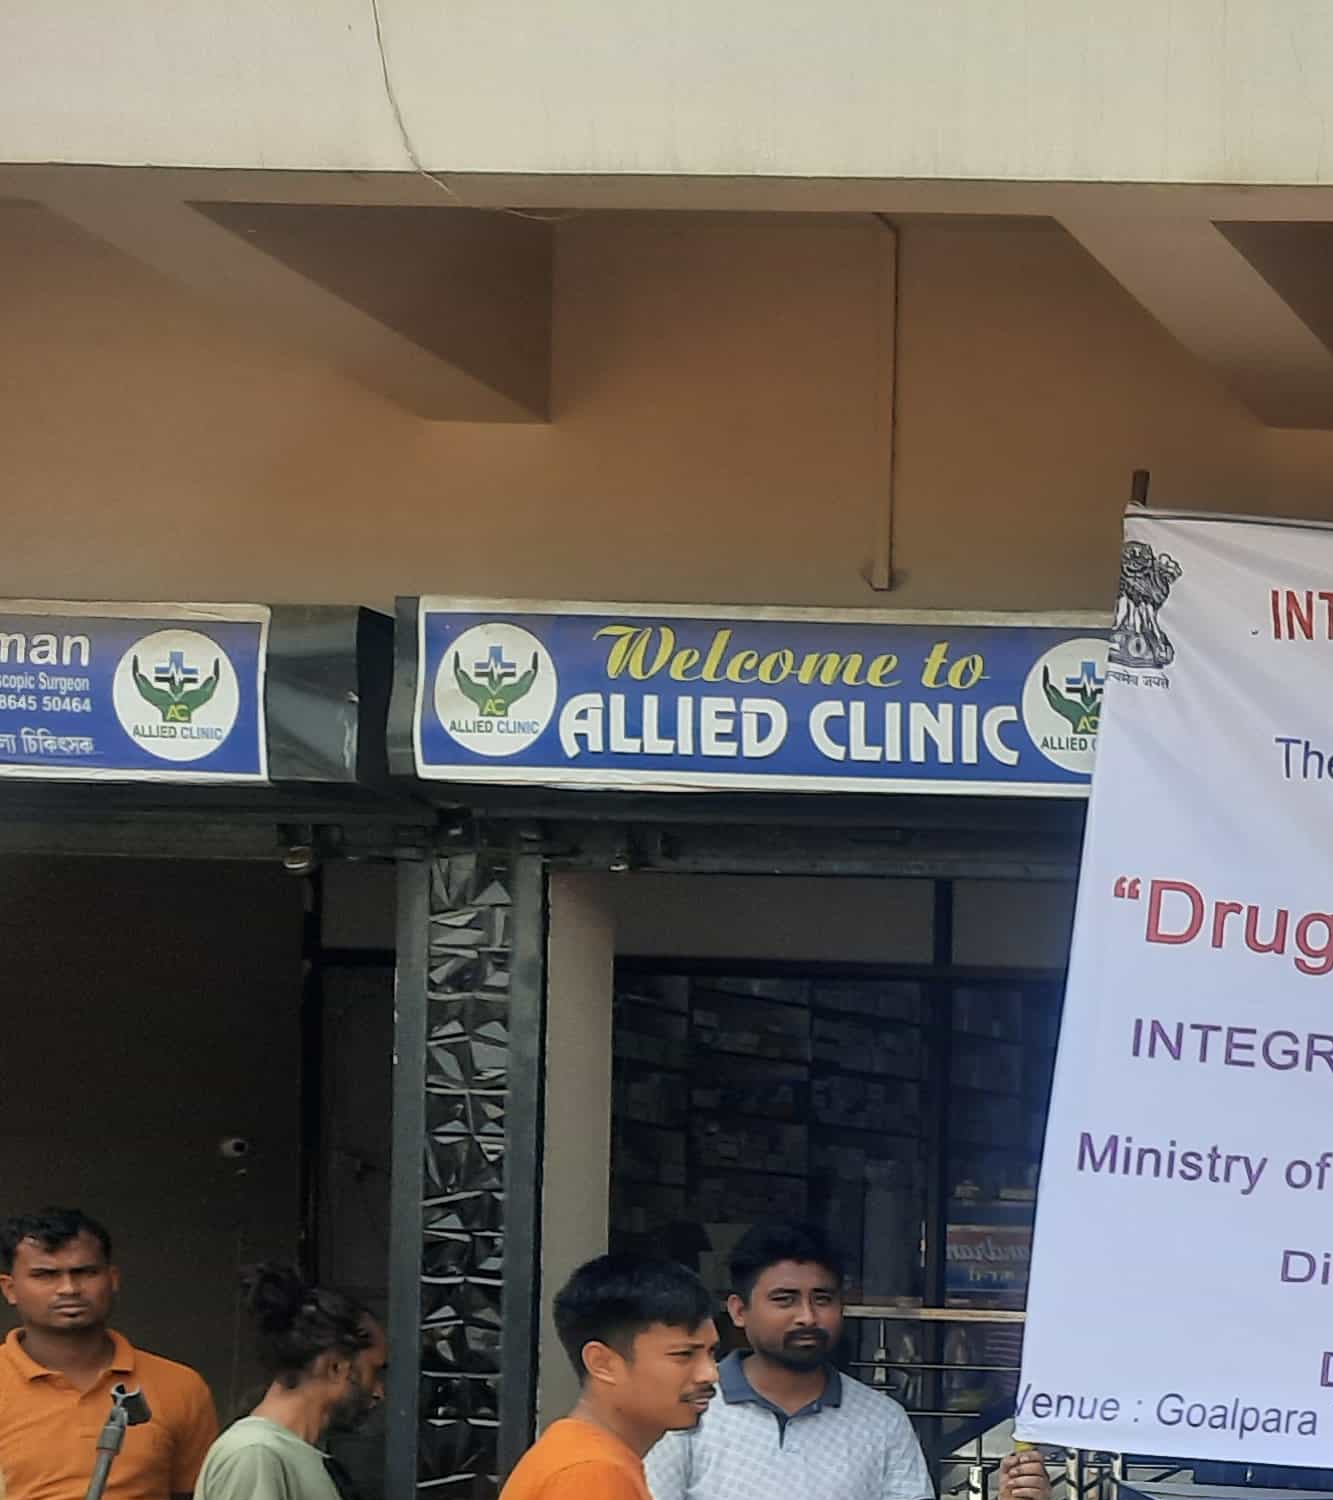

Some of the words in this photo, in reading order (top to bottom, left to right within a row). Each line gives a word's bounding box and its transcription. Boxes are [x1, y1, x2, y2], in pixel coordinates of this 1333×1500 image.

[592, 624, 902, 688] Welcome
[920, 639, 990, 689] to
[0, 672, 36, 692] copic
[38, 671, 91, 695] Surgeon
[41, 695, 92, 713] 50464
[166, 703, 189, 721] AC
[482, 698, 506, 716] AC
[132, 725, 177, 739] ALLIED
[180, 727, 223, 741] CLINIC
[449, 720, 493, 735] ALLIED
[497, 720, 540, 735] CLINIC
[558, 692, 790, 760] ALLIED
[808, 700, 1021, 767] CLINIC
[1039, 736, 1089, 752] ALLIED
[1075, 1131, 1268, 1197] Ministry
[1284, 1148, 1331, 1192] of
[1156, 1392, 1318, 1441] Goalpara
